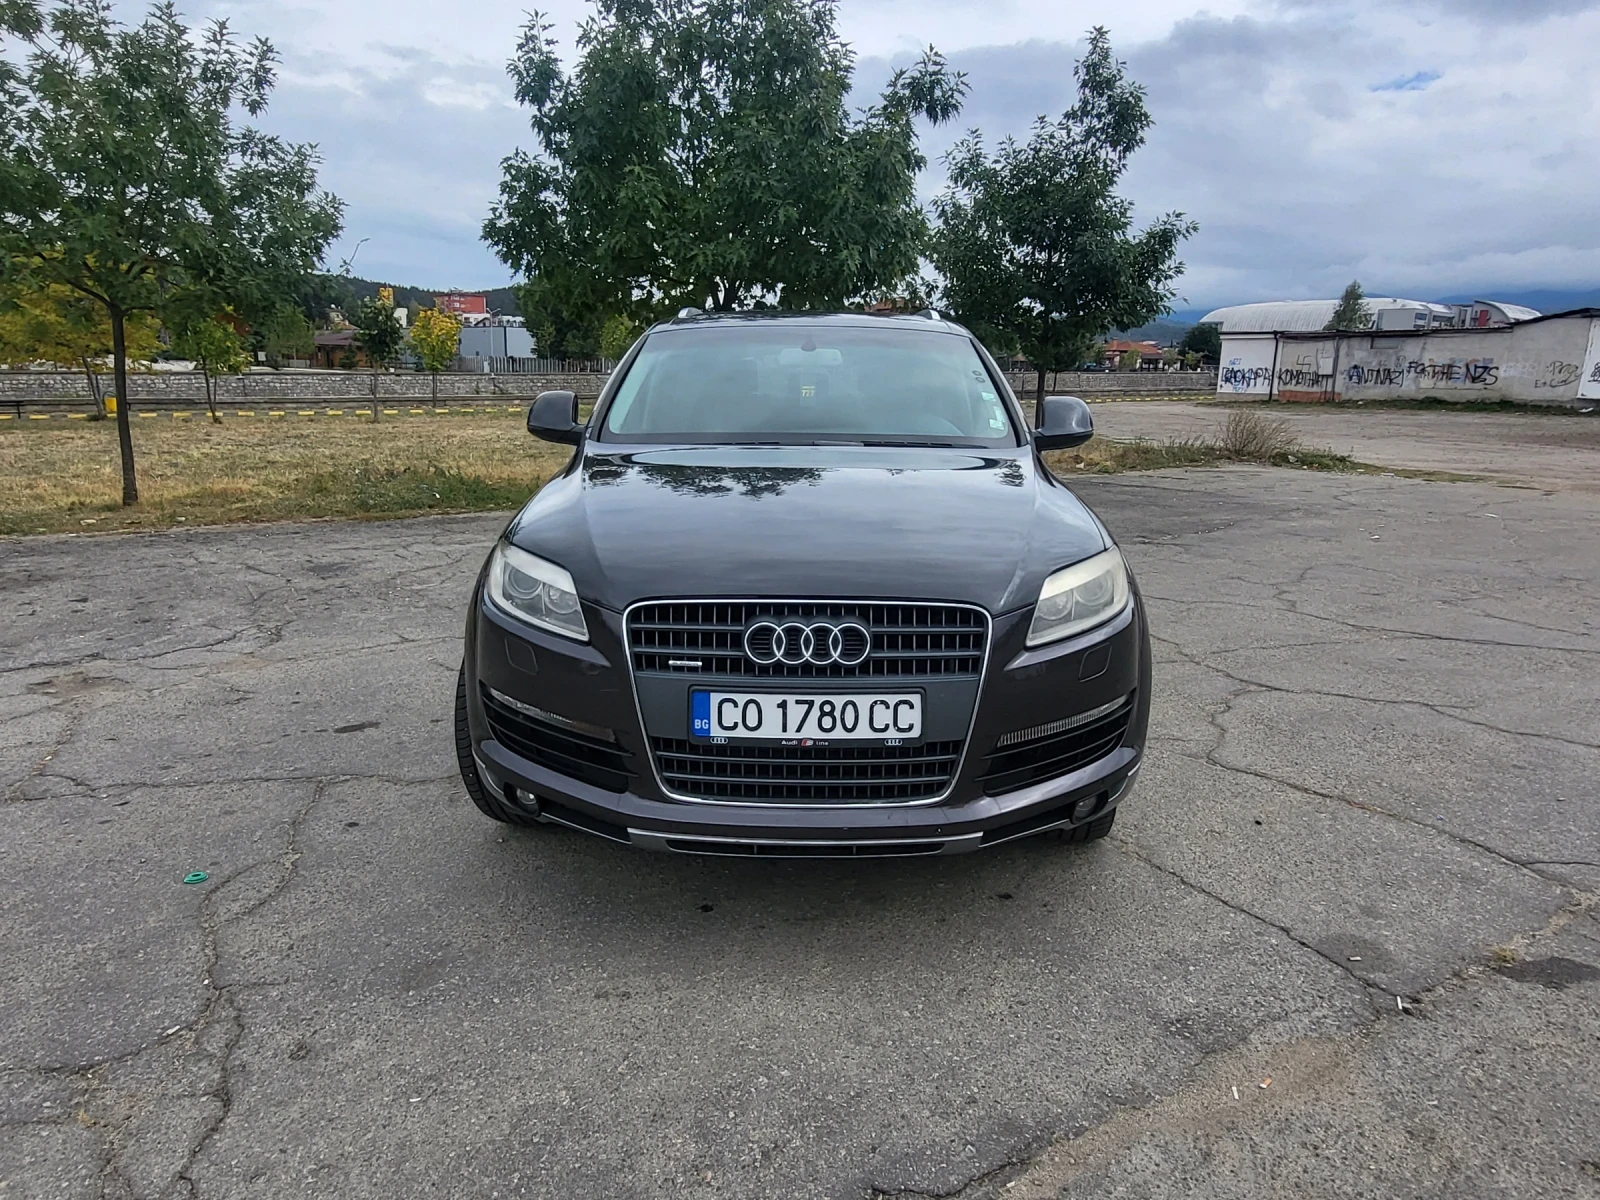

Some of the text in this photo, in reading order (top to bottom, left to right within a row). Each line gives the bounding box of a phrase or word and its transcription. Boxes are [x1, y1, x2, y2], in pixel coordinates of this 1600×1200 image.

[694, 718, 709, 730] BG
[717, 697, 915, 733] CO 1780 CC
